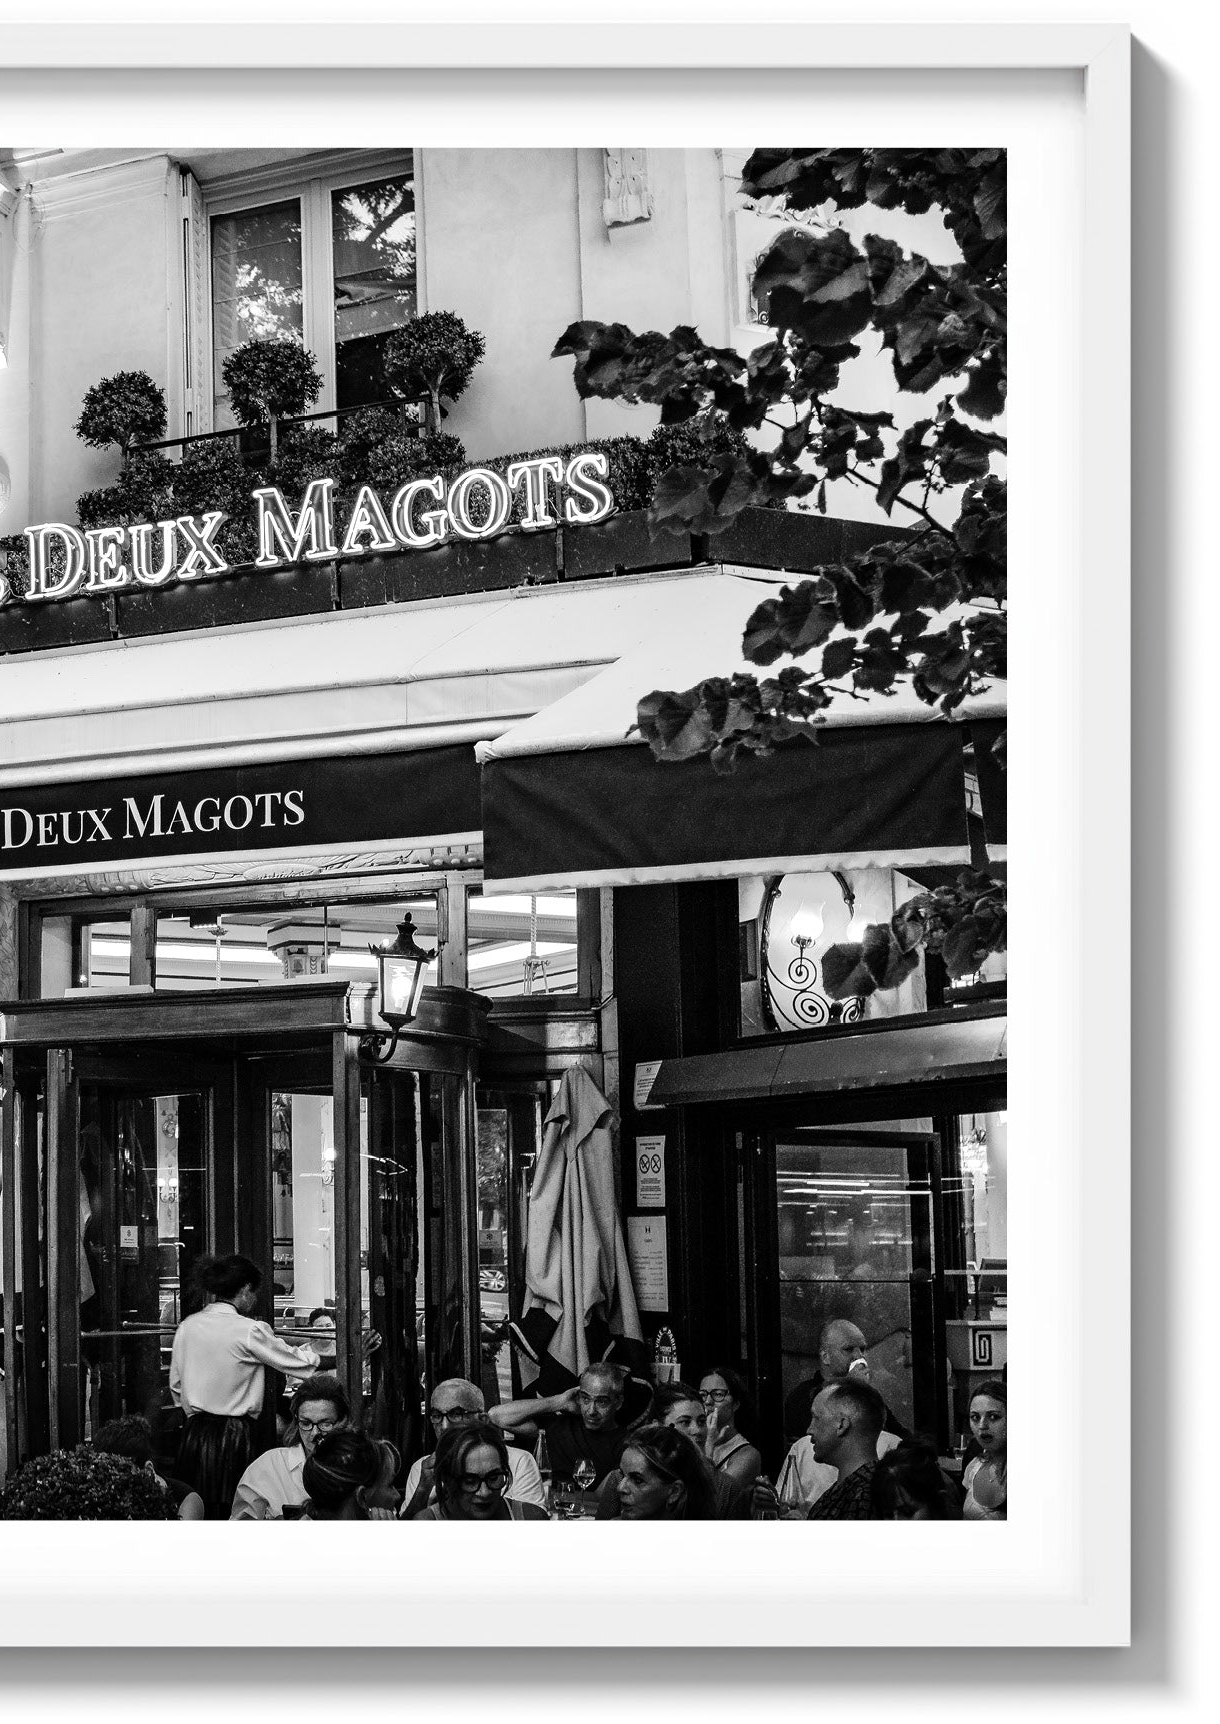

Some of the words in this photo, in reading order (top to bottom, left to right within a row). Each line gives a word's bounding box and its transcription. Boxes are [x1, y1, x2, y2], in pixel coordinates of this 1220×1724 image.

[24, 512, 228, 600] DEUX
[253, 454, 616, 567] MAGOTS
[1, 807, 113, 850] DEUX
[122, 790, 306, 839] MAGOTS
